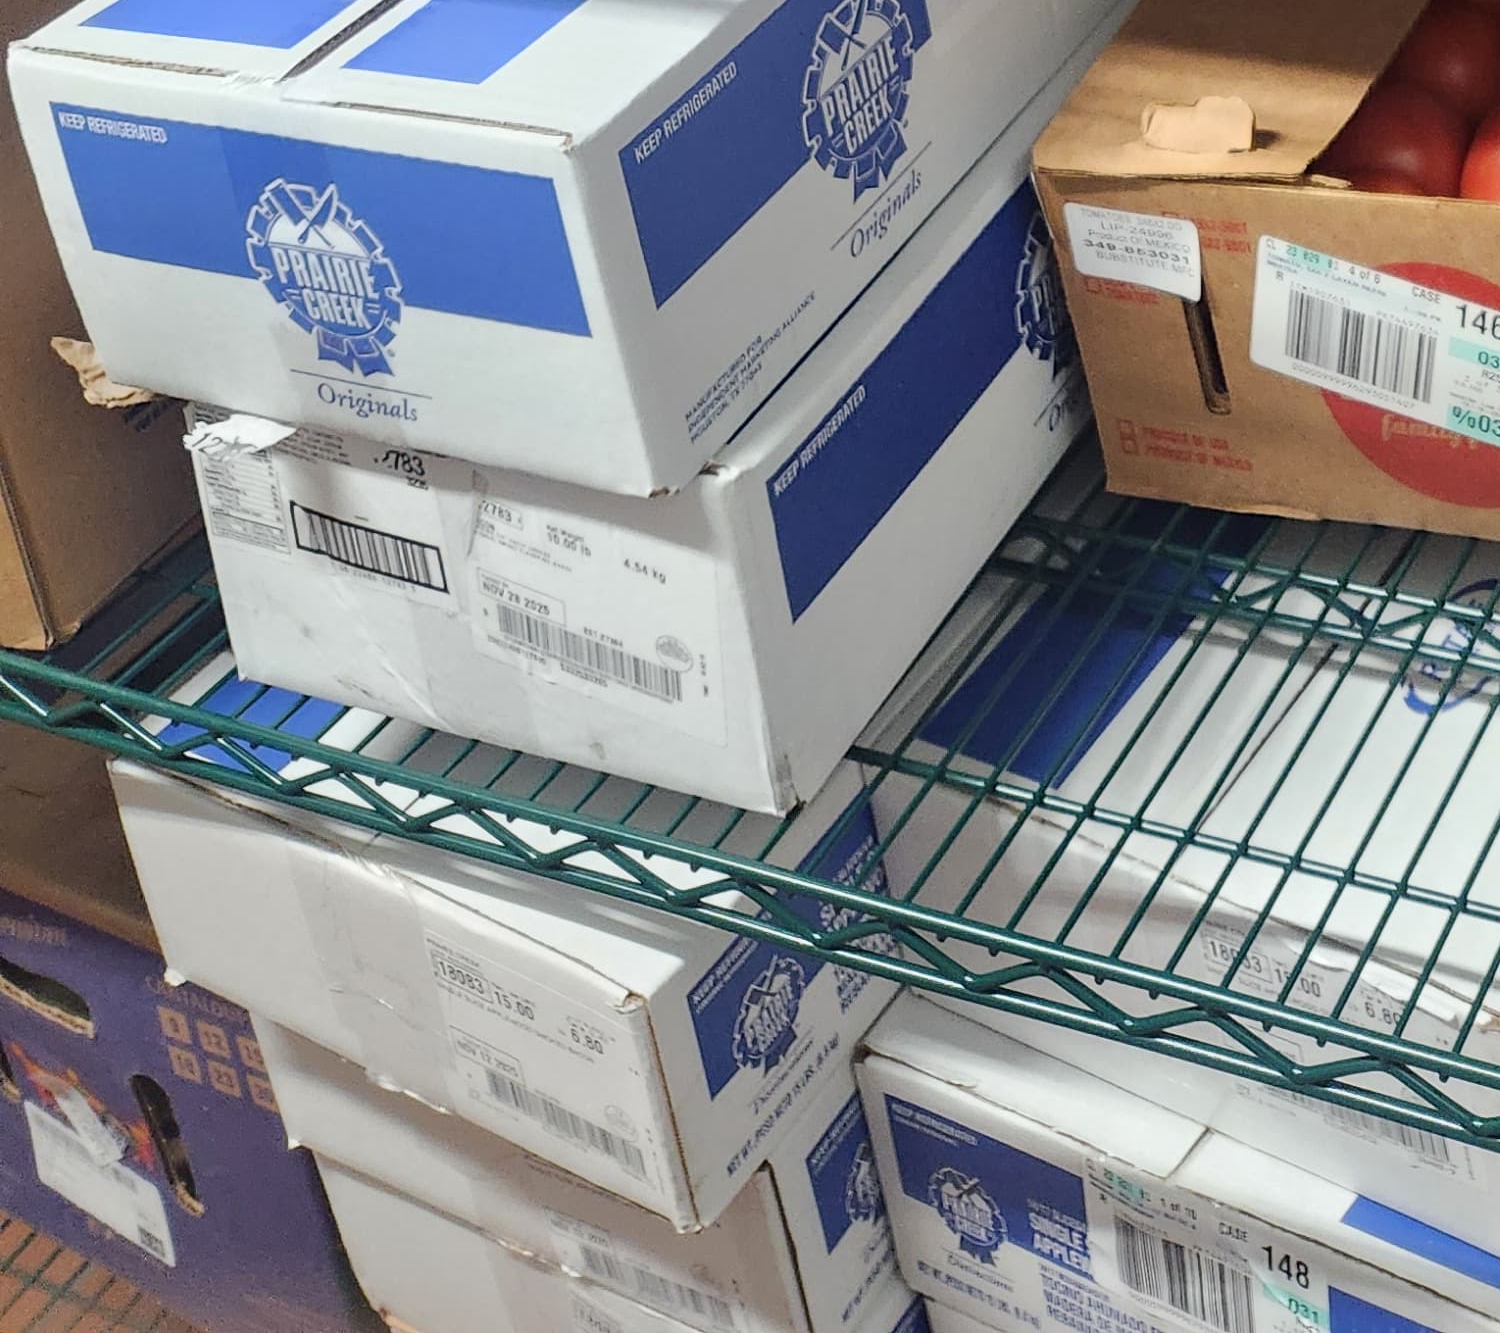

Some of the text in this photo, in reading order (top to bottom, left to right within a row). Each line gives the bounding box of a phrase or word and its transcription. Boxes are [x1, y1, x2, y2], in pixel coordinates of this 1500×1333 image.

[821, 35, 899, 136] PRAIRIE
[59, 112, 167, 144] KEEP REFRIGERATED
[634, 61, 738, 164] KEEP REFRIGERATED
[845, 90, 893, 154] CREEK
[850, 170, 922, 258] Originals
[271, 247, 380, 300] PRAIRIE
[1412, 287, 1441, 304] CASE
[302, 294, 371, 329] CREEK
[317, 382, 418, 422] Originals
[773, 385, 867, 496] KEEP REFRIGERATED
[483, 581, 505, 598] NOV
[524, 597, 550, 616] 2025
[494, 991, 535, 1021] 15.00
[1261, 1245, 1309, 1290] 148
